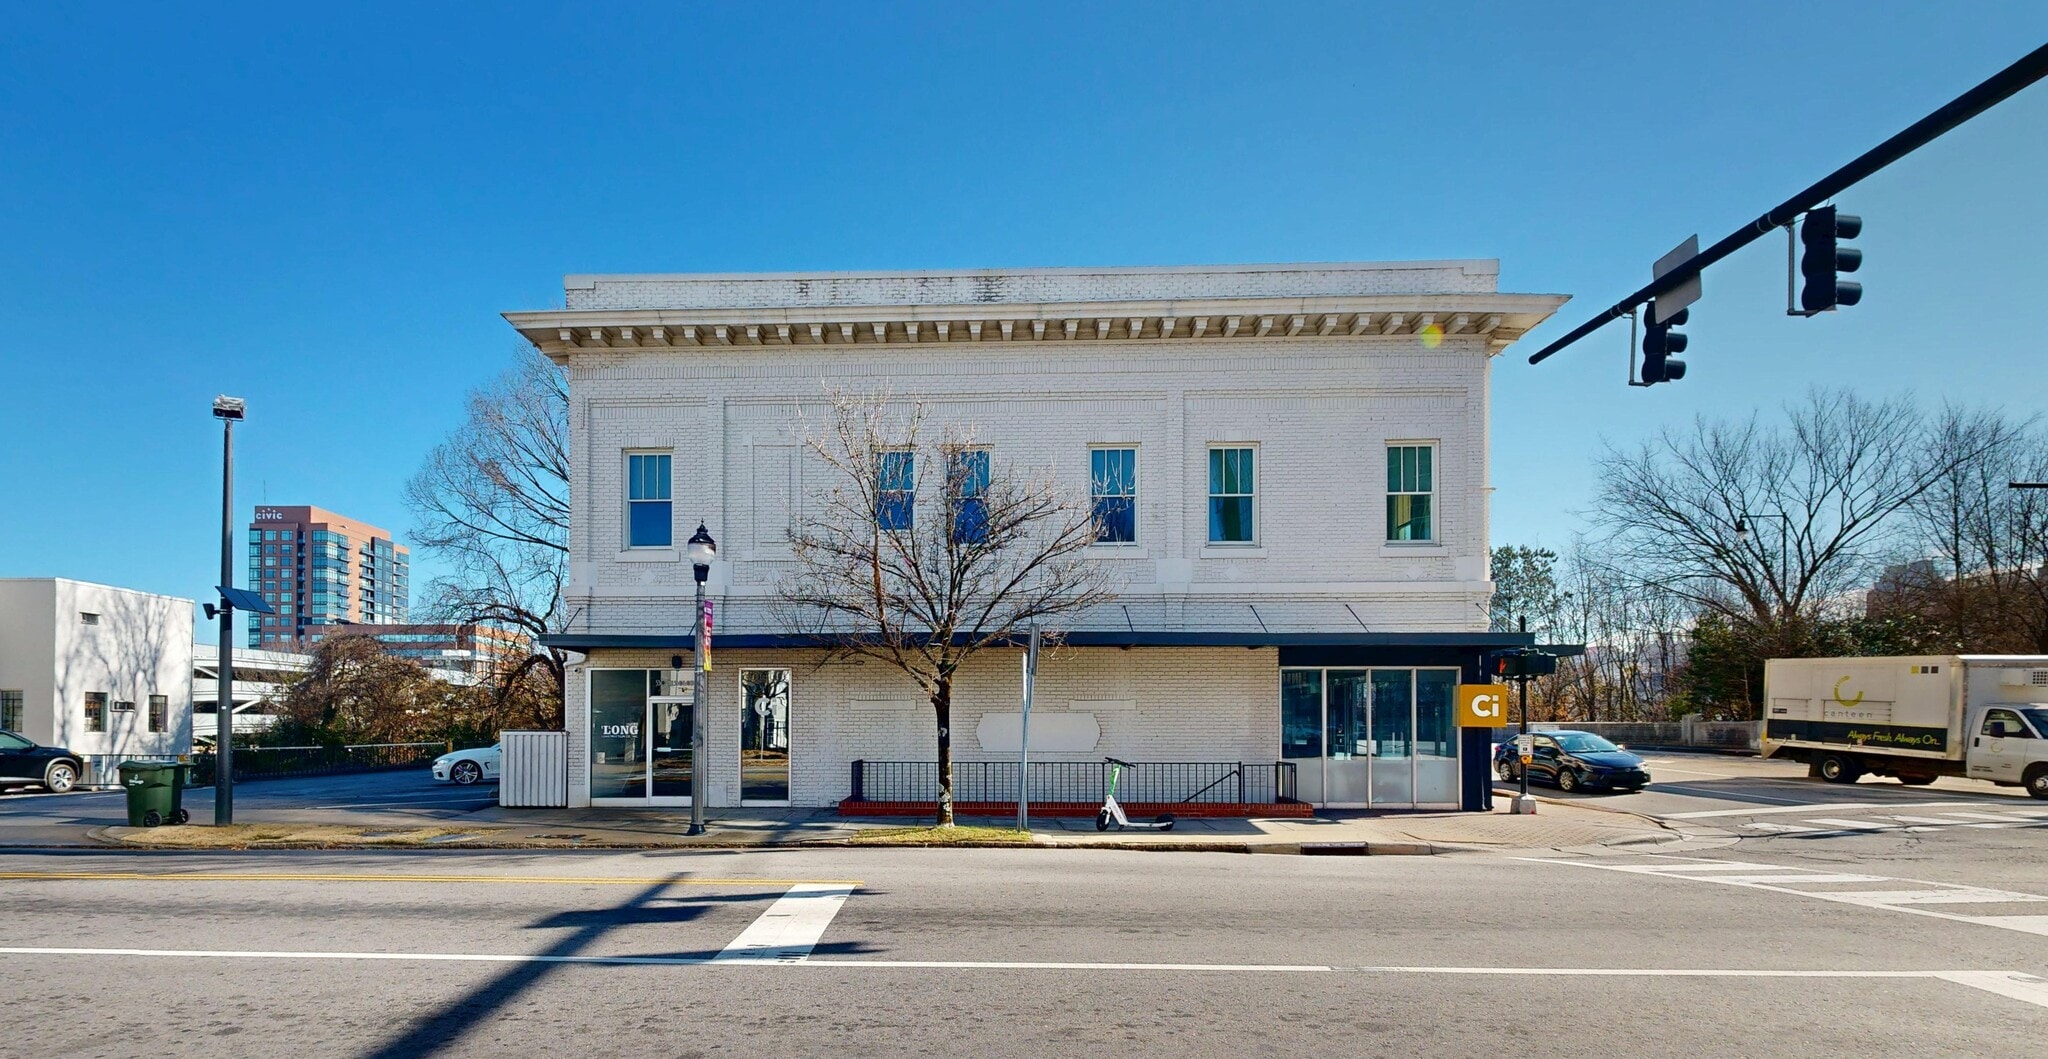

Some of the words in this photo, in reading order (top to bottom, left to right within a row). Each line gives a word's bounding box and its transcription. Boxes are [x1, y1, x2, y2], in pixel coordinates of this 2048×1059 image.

[256, 508, 283, 520] civic
[1471, 694, 1499, 717] Ci
[1823, 709, 1873, 719] canteen
[1847, 729, 1873, 743] Always
[1893, 733, 1921, 746] Always
